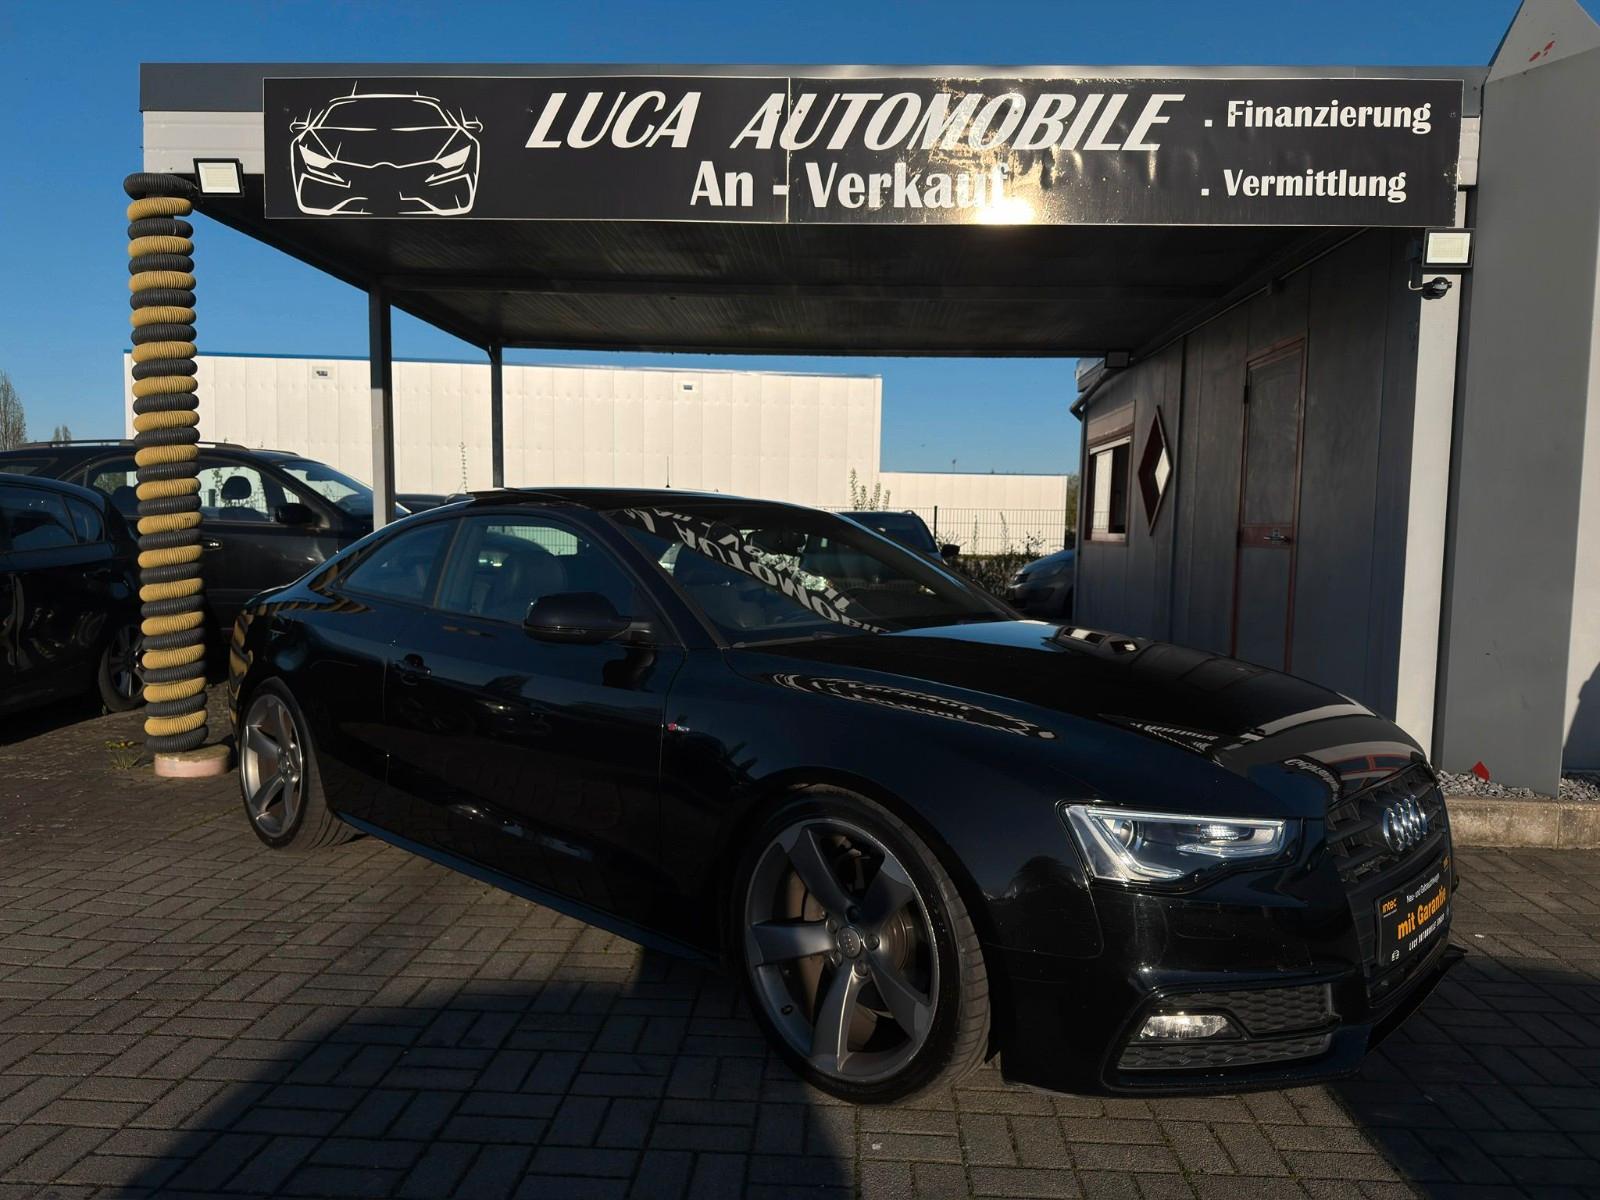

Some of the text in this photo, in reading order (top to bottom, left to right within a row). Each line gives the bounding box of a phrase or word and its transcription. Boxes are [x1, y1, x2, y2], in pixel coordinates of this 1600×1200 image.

[525, 92, 1186, 151] LUCA AUTOMOBILE
[1227, 99, 1432, 135] Finanzierung
[690, 160, 755, 208] An
[805, 162, 1009, 209] Verkauf
[1223, 168, 1408, 204] Vermittlung
[1397, 912, 1415, 940] mit
[1417, 886, 1446, 925] Garantie
